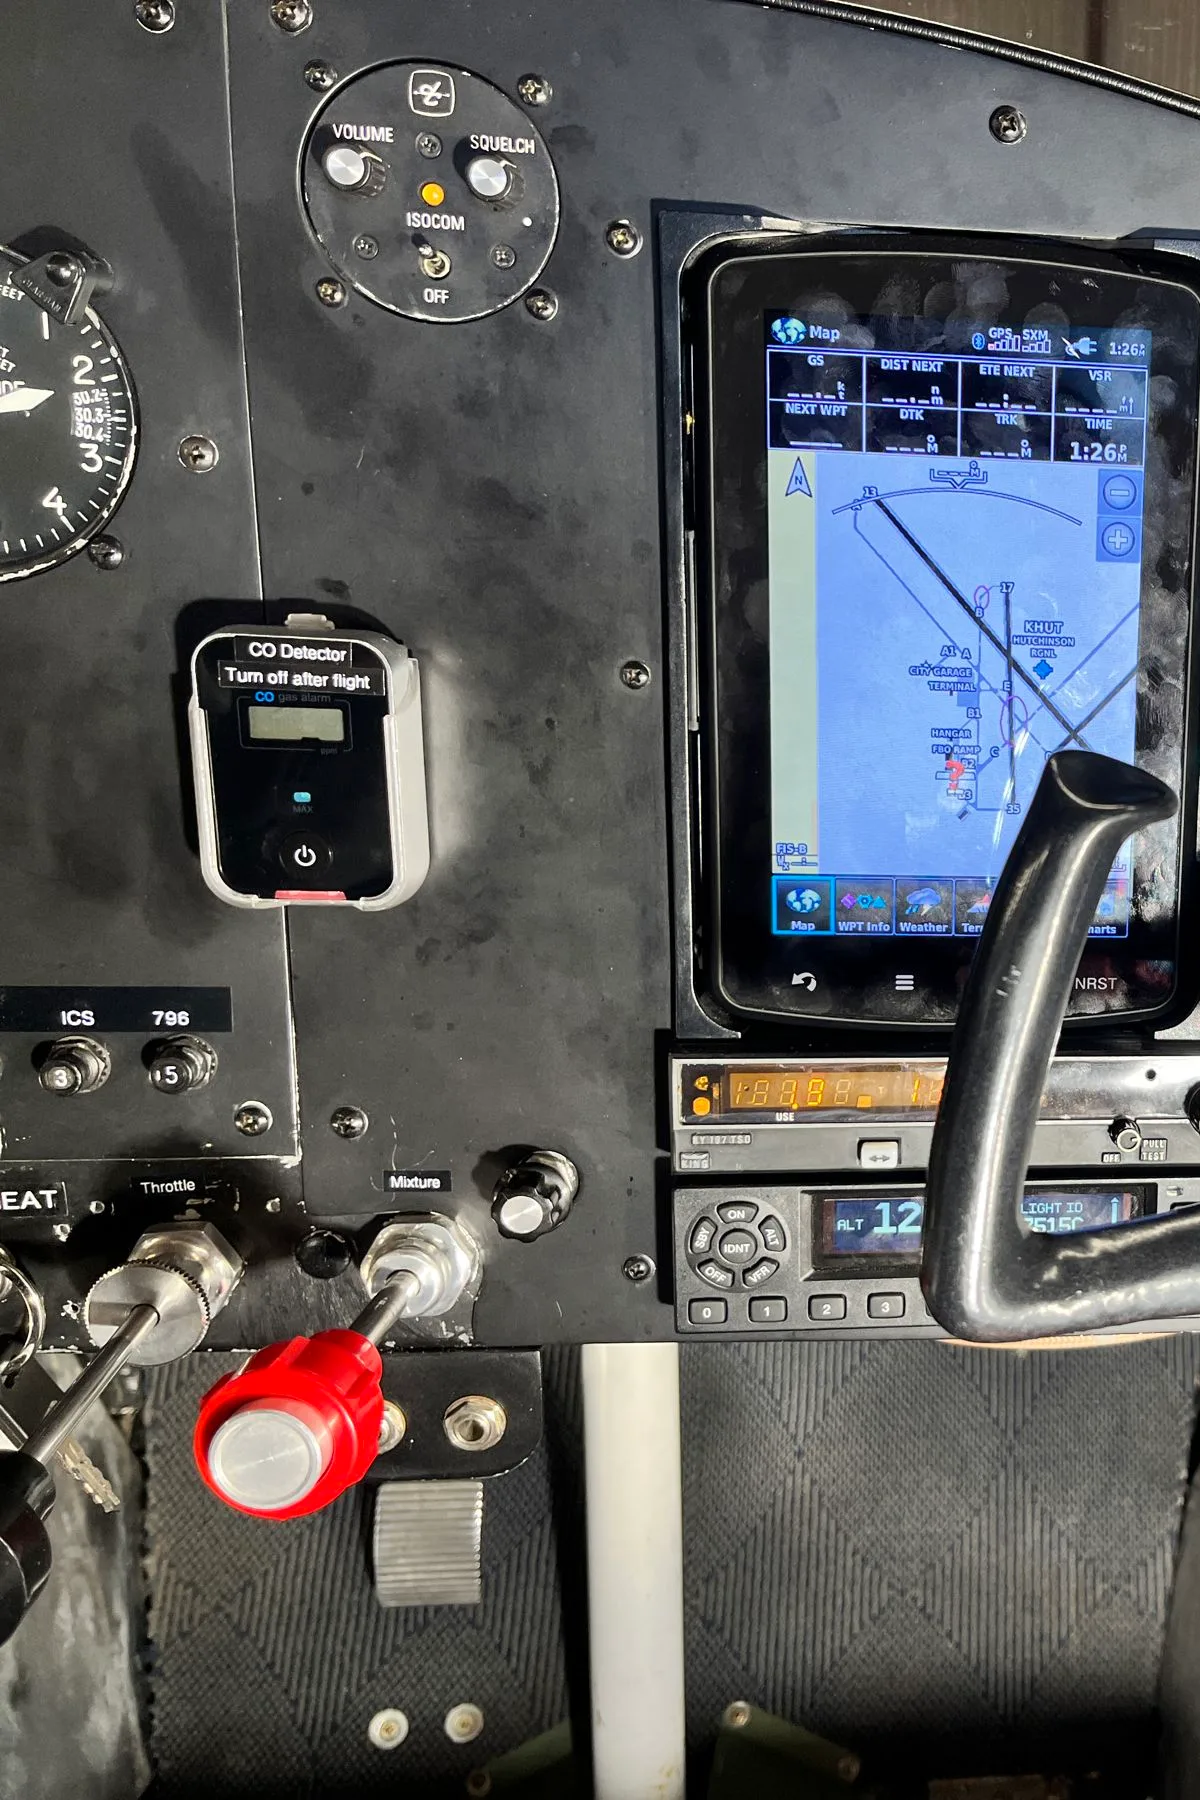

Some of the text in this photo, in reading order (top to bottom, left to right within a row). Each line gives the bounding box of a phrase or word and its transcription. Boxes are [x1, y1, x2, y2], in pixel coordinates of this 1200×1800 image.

[333, 123, 394, 143] VOLUME
[470, 134, 535, 154] SQUELCH
[406, 211, 465, 231] ISOCOM
[423, 288, 449, 304] OFF
[808, 325, 841, 343] Map
[988, 327, 1049, 342] GPS SXM
[1109, 342, 1140, 356] 1:26
[807, 355, 825, 367] GS
[880, 359, 944, 373] DIST NEXT
[72, 354, 96, 385] 2
[979, 364, 1036, 378] ETE NEXT
[1088, 370, 1113, 382] VSR
[74, 407, 104, 424] 30.3
[785, 402, 848, 417] NEXT WPT
[899, 409, 925, 421] DTK
[994, 413, 1018, 425] TRK
[1084, 418, 1113, 430] TIME
[79, 442, 103, 473] 3
[1070, 441, 1117, 462] 1:26
[794, 475, 803, 485] N
[863, 486, 879, 499] 13
[42, 486, 68, 516] 4
[1000, 582, 1015, 595] 17
[974, 605, 985, 620] B
[1024, 620, 1064, 635] KHUT
[1012, 636, 1075, 648] HUTCHINSON
[249, 642, 347, 662] CO Detector
[940, 646, 957, 659] A1
[961, 648, 973, 661] A
[1030, 649, 1057, 659] RGNL
[909, 666, 972, 678] CITY GARAGE
[225, 667, 371, 691] Turn off after flight
[928, 681, 976, 693] TERMINAL
[1002, 681, 1012, 692] E
[255, 691, 331, 704] CO gas alarm
[967, 706, 982, 719] B1
[931, 729, 972, 740] HANGAR
[932, 745, 982, 756] FBO RAMP
[989, 747, 1000, 758] C
[1007, 803, 1021, 815] 35
[776, 843, 807, 855] FIS-B
[791, 920, 815, 933] Map
[838, 921, 890, 934] WPT Info
[900, 922, 948, 934] Weather
[1075, 976, 1117, 990] NRST
[61, 1010, 96, 1026] ICS
[152, 1010, 190, 1026] 796
[54, 1069, 68, 1087] 3
[165, 1065, 179, 1084] 5
[775, 1112, 795, 1122] USE
[1142, 1139, 1166, 1149] PULL
[1103, 1153, 1120, 1163] OFF
[1141, 1151, 1166, 1161] TEST
[681, 1160, 709, 1169] KING
[140, 1179, 196, 1195] Throttle
[390, 1175, 442, 1190] Mixture
[0, 1190, 59, 1210] EAT
[727, 1209, 745, 1220] ON
[1020, 1202, 1084, 1214] LIGHT ID
[873, 1201, 922, 1234] 12
[836, 1218, 864, 1232] ALT
[694, 1227, 709, 1249] SBY
[764, 1227, 779, 1247] ALT
[723, 1241, 751, 1254] IDNT
[704, 1266, 727, 1284] OFF
[748, 1265, 771, 1284] VFR
[702, 1307, 712, 1320] 0
[763, 1305, 771, 1318] 1
[822, 1303, 832, 1316] 2
[880, 1301, 891, 1315] 3
